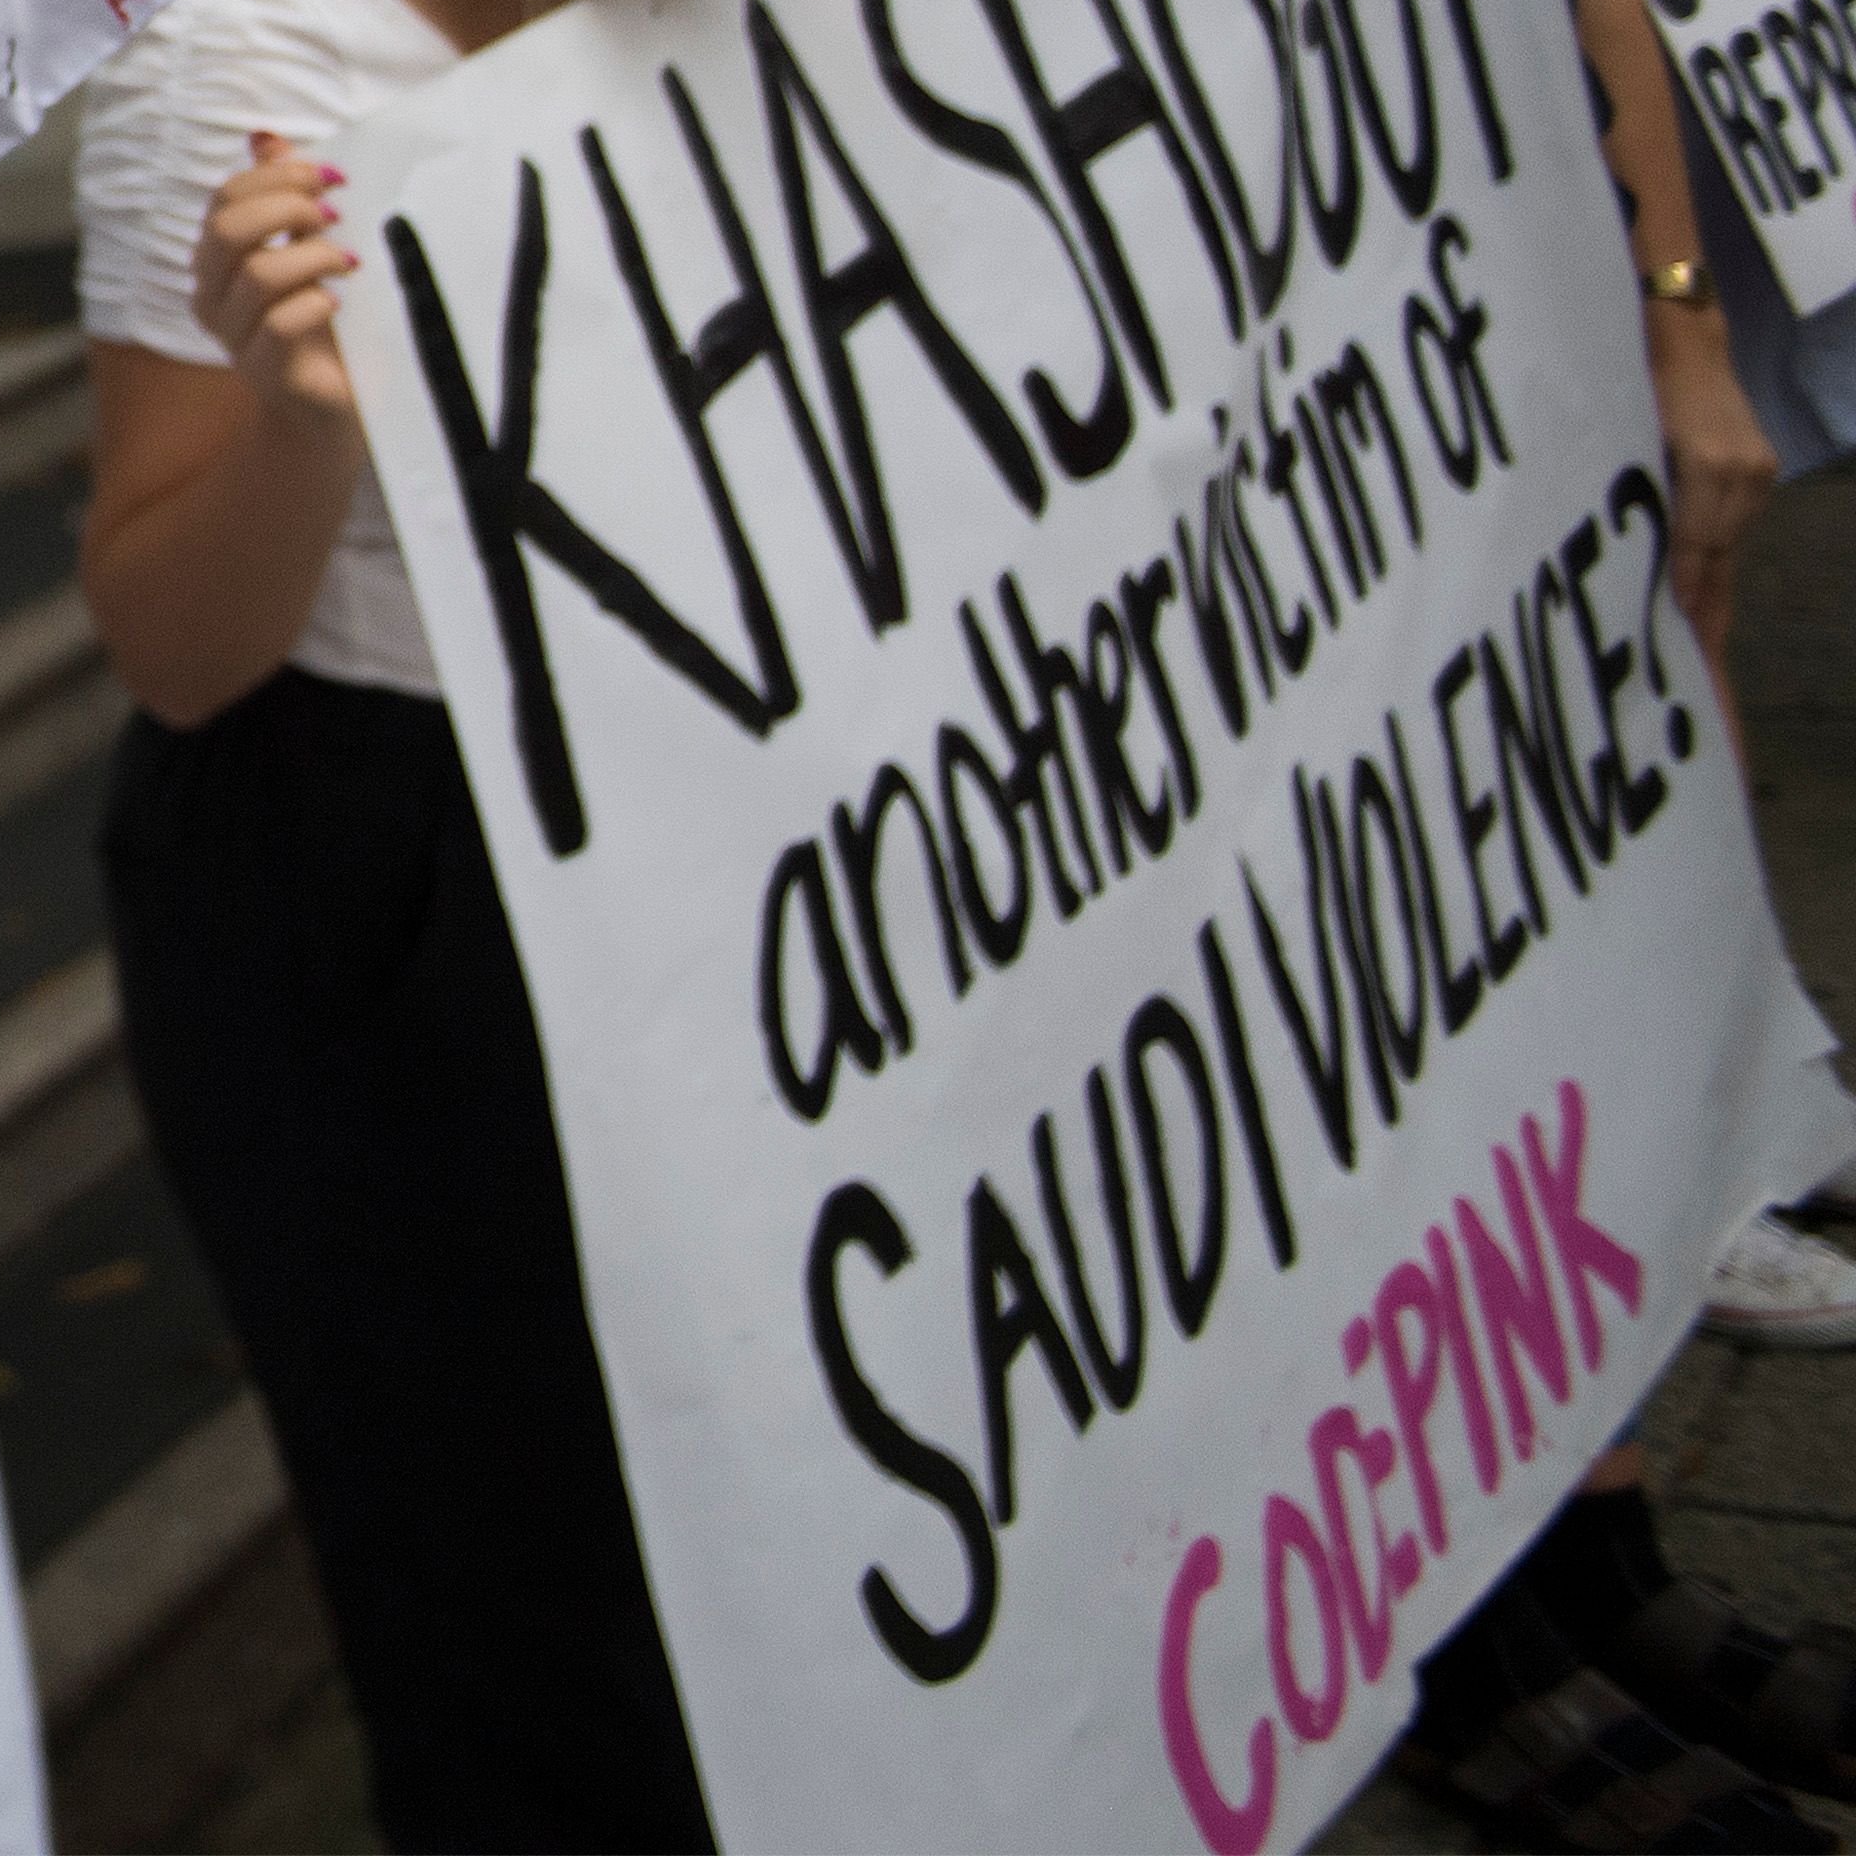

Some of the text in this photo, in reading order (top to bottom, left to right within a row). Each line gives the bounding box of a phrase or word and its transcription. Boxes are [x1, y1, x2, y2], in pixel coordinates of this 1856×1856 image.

[758, 212, 1516, 1124] another victim of
[805, 462, 1696, 1686] SAUDI VIOLENCE?
